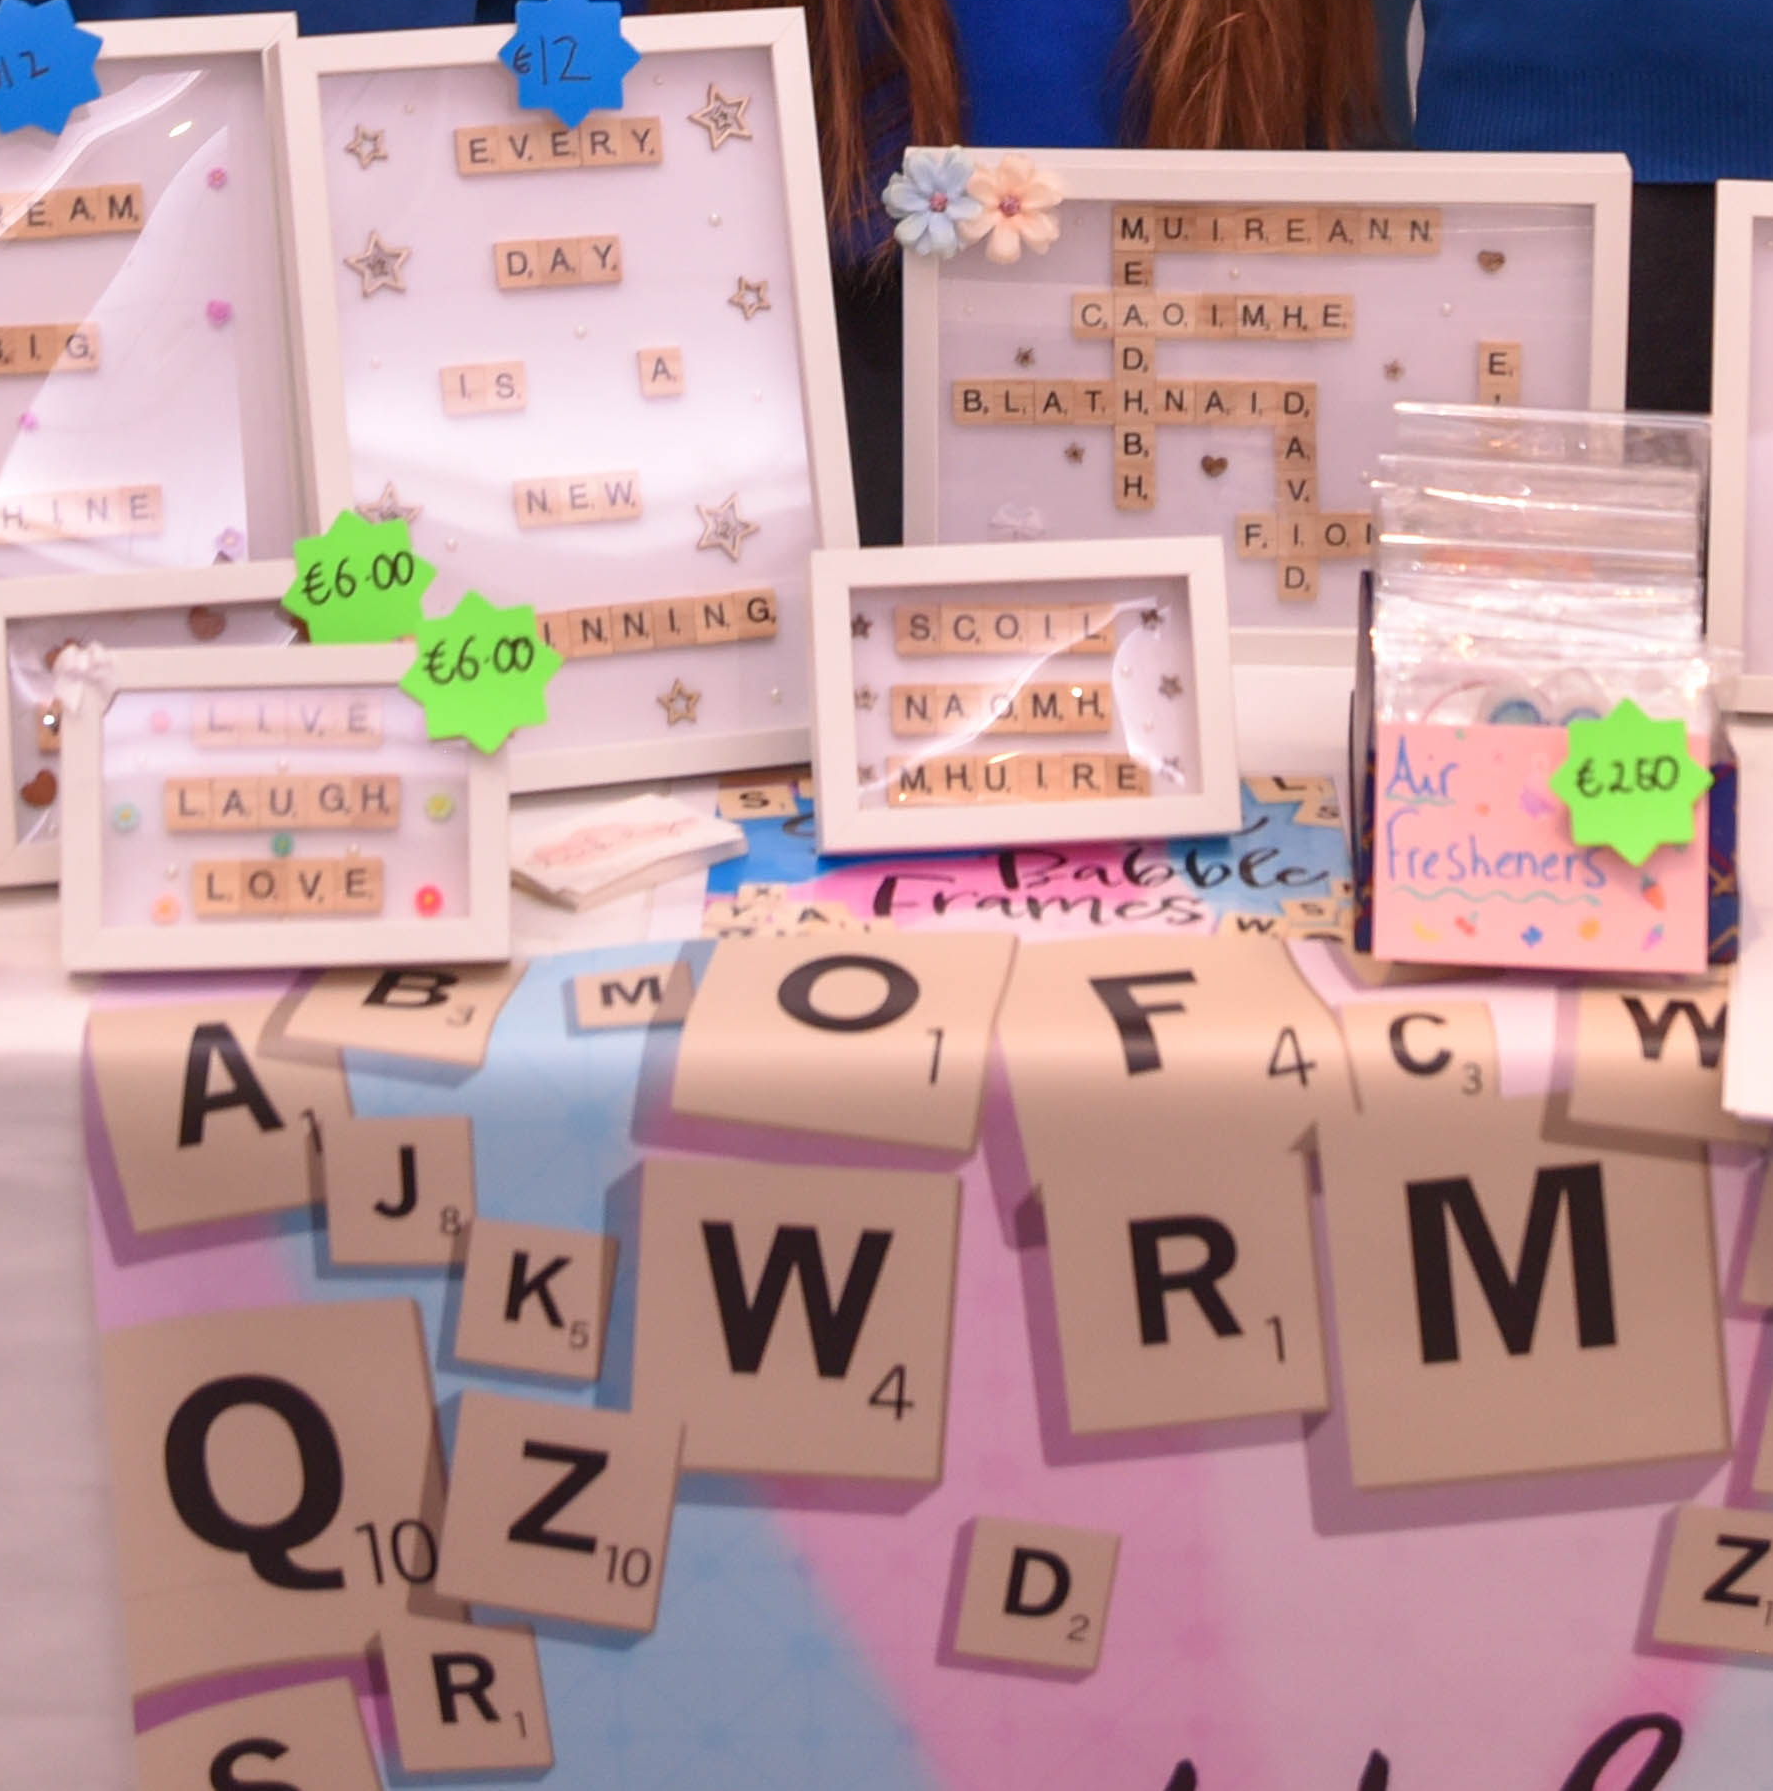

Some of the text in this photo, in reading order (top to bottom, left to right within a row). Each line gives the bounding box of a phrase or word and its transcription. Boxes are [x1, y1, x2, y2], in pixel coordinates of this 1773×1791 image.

[512, 35, 592, 86] €12
[470, 128, 657, 166] EVERY
[1120, 215, 1433, 245] MUIREANN
[506, 241, 618, 278] DAY
[1080, 302, 1349, 332] CAOIMHE
[458, 355, 678, 400] IS A
[962, 388, 1312, 417] BLATHNAID
[526, 481, 637, 513] NEW
[301, 549, 415, 607] €6.00
[543, 596, 778, 648] INNING
[909, 611, 1110, 643] SCOIL
[424, 633, 535, 687] €6.00
[207, 704, 373, 737] LIVE
[904, 691, 1104, 723] NAOMH
[900, 764, 1143, 795] MHUIRE
[1385, 733, 1459, 800] Air
[178, 781, 391, 820] LAUGH
[1386, 806, 1608, 891] Fresheners
[207, 867, 374, 904] LOVE
[995, 846, 1329, 892] Babble
[872, 873, 1207, 926] Frames
